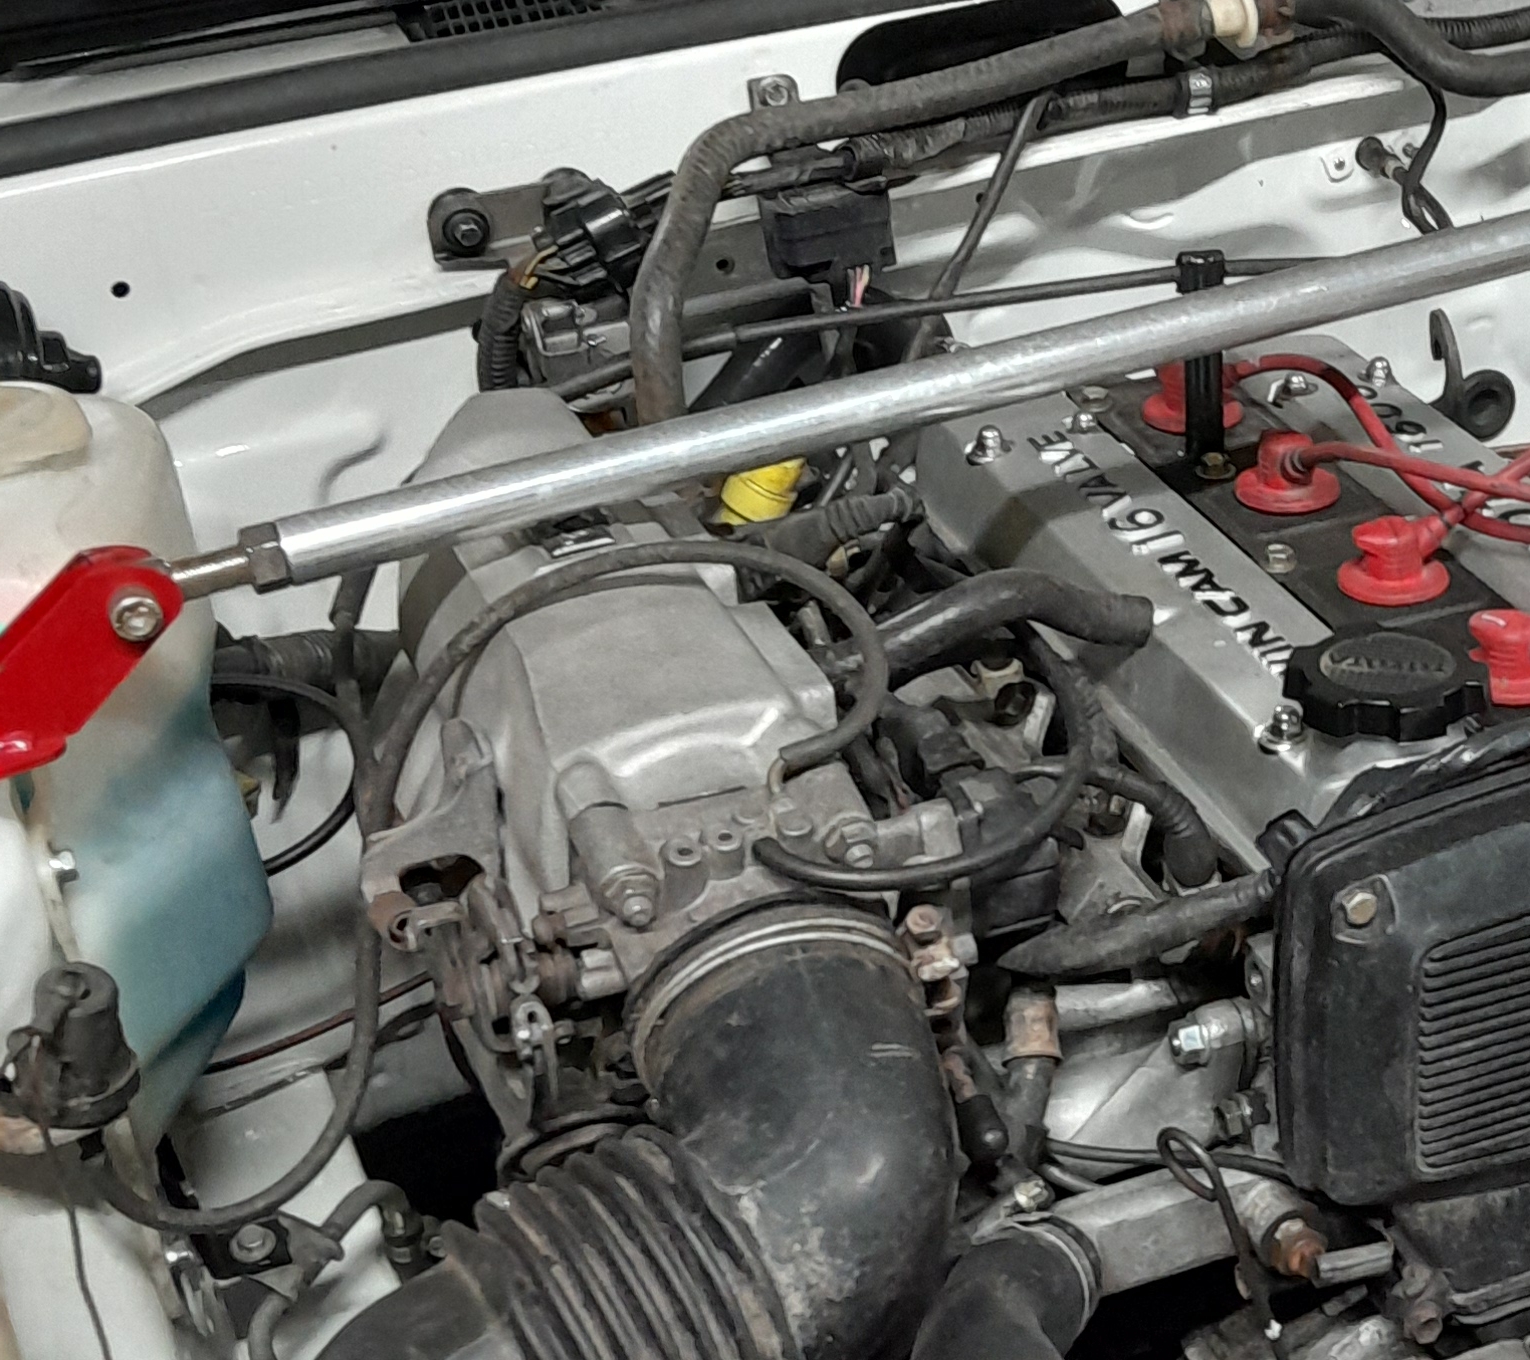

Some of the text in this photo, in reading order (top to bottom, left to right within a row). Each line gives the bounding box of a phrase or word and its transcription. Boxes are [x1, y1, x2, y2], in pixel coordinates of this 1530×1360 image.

[1026, 430, 1133, 519] VALVE
[1106, 508, 1186, 556] 16
[1157, 550, 1251, 626] CAM
